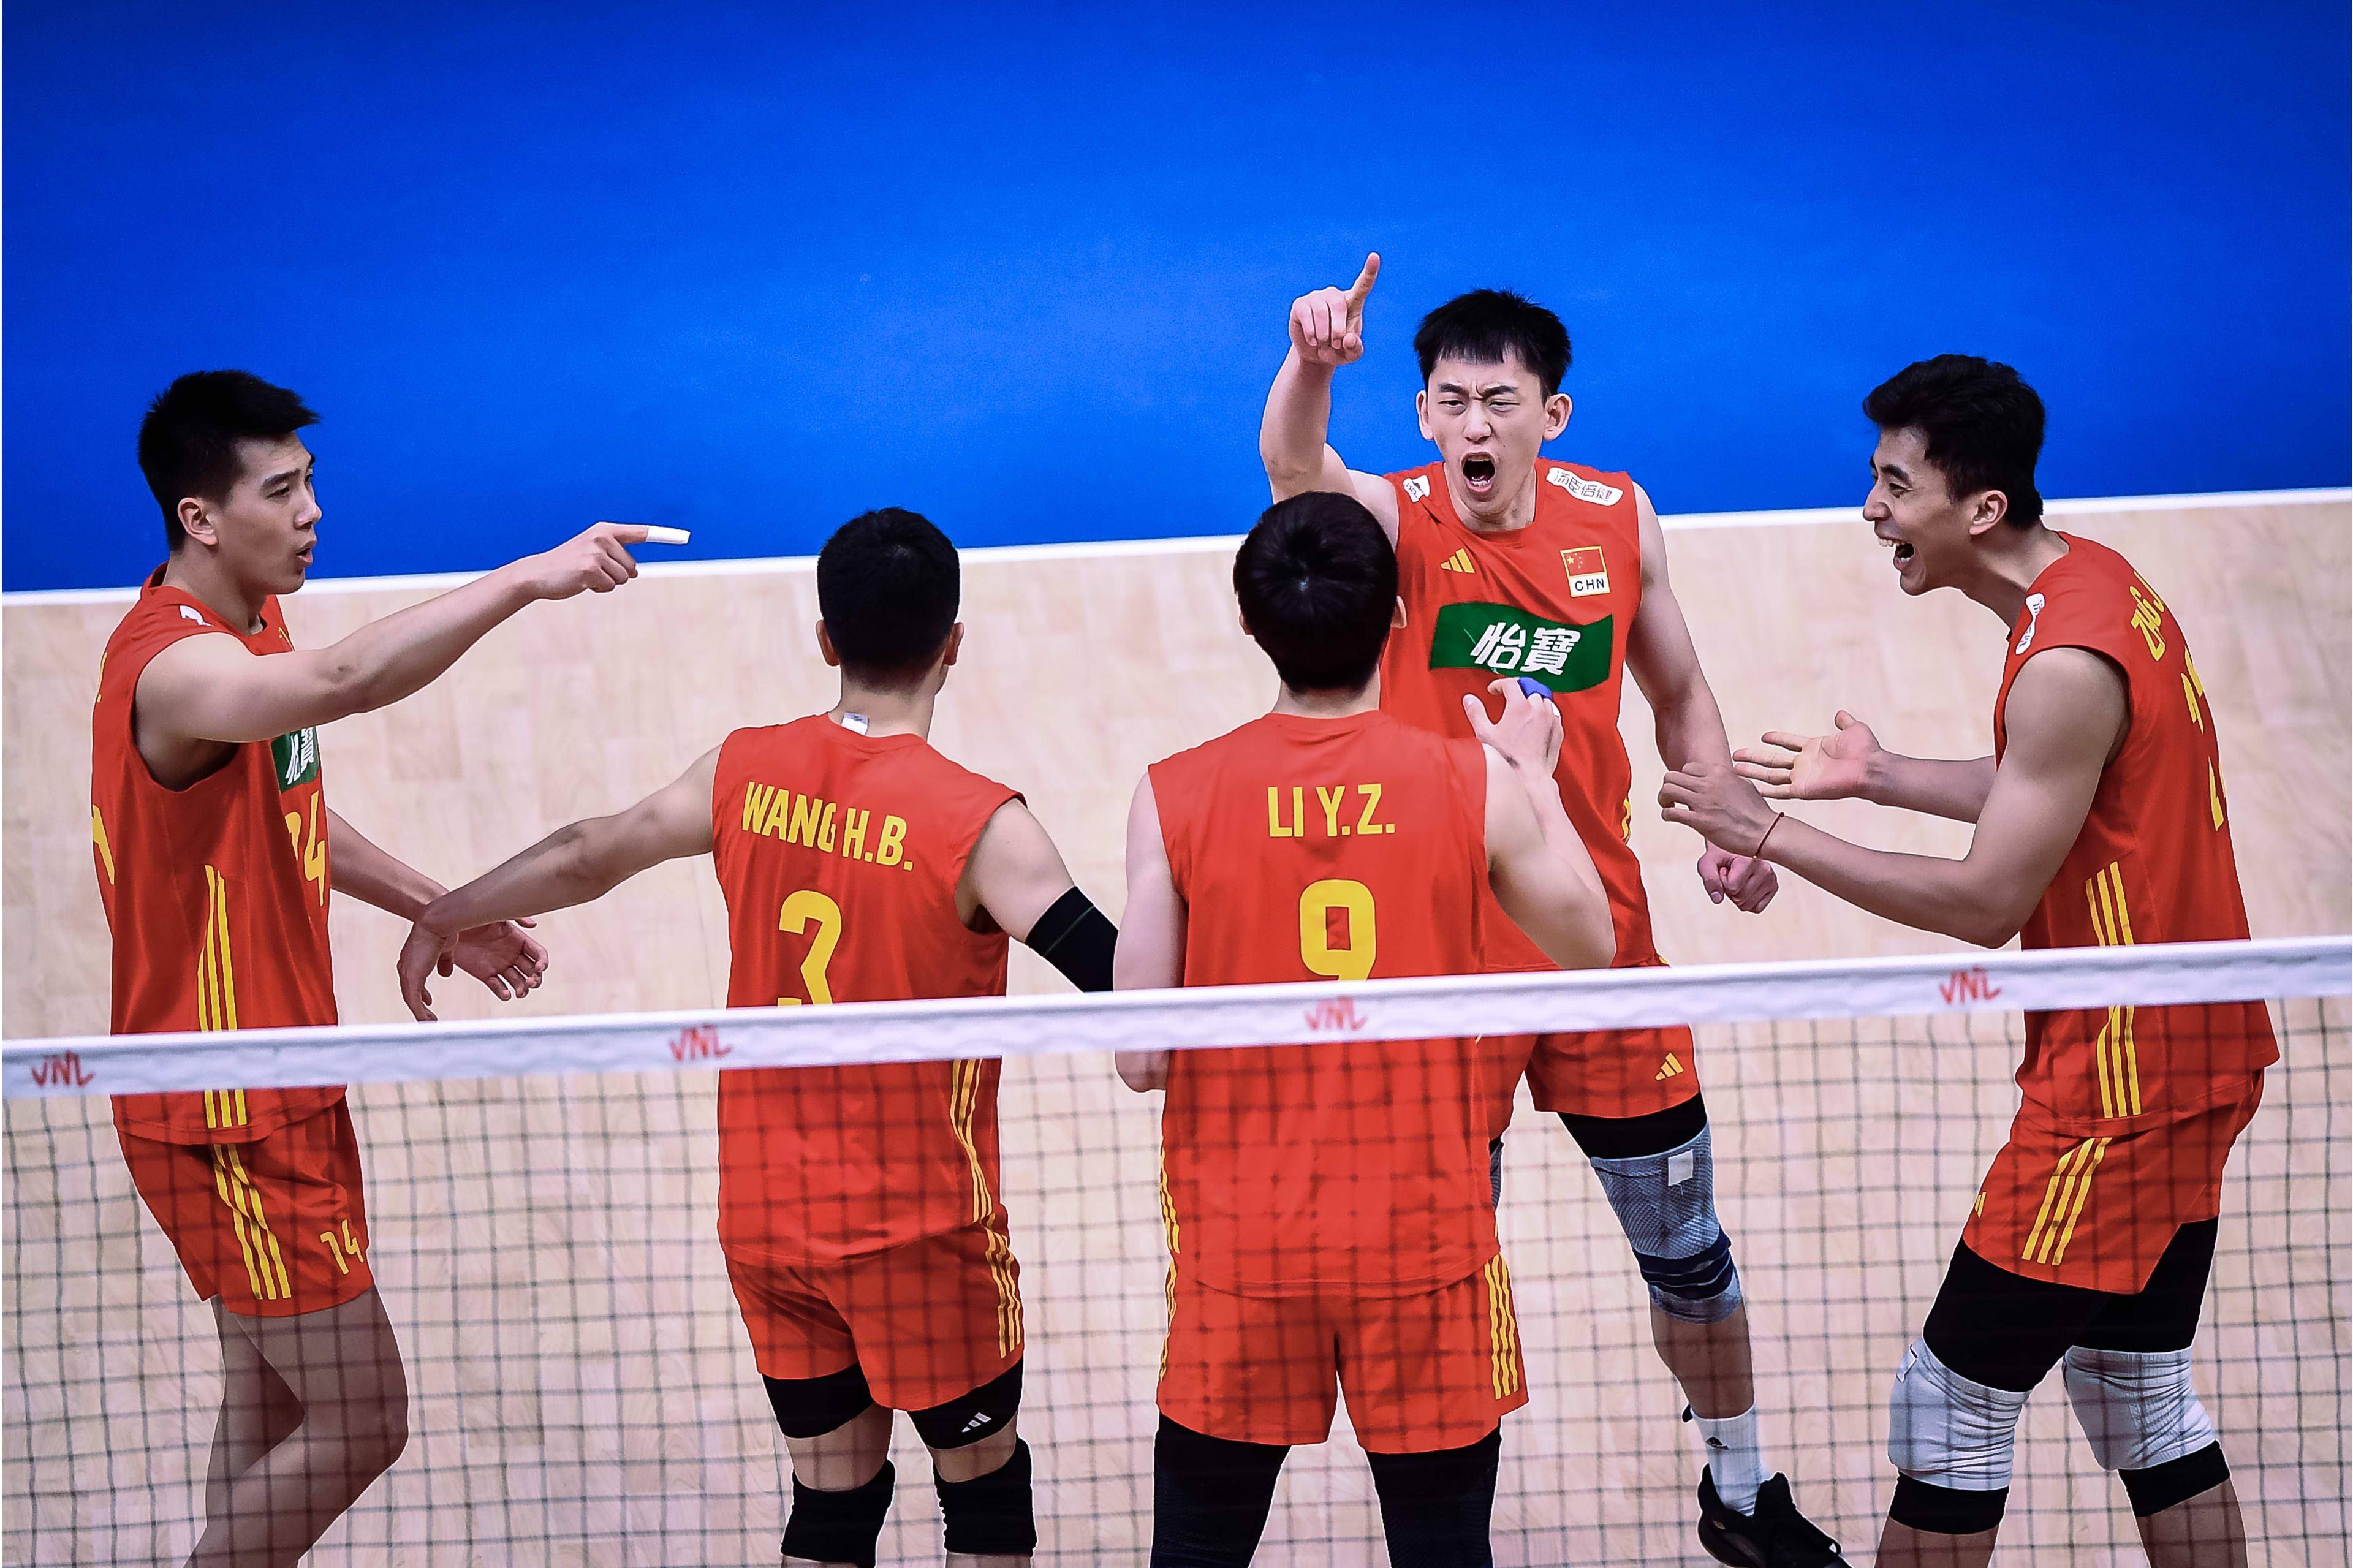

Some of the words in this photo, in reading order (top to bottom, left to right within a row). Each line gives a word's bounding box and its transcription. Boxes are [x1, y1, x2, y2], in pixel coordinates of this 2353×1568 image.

[1575, 578, 1605, 591] CHN
[1469, 621, 1581, 676] 怡寶
[741, 781, 837, 854] WANG
[841, 806, 914, 871] H.B.
[1267, 786, 1304, 838] LI
[1316, 782, 1395, 837] Y.Z.
[1299, 879, 1377, 982] 9
[1939, 965, 2001, 1005] VNL
[1305, 995, 1368, 1031] VNL
[669, 1023, 733, 1062] VNL
[32, 1050, 96, 1088] VNL
[320, 1219, 365, 1275] 14
